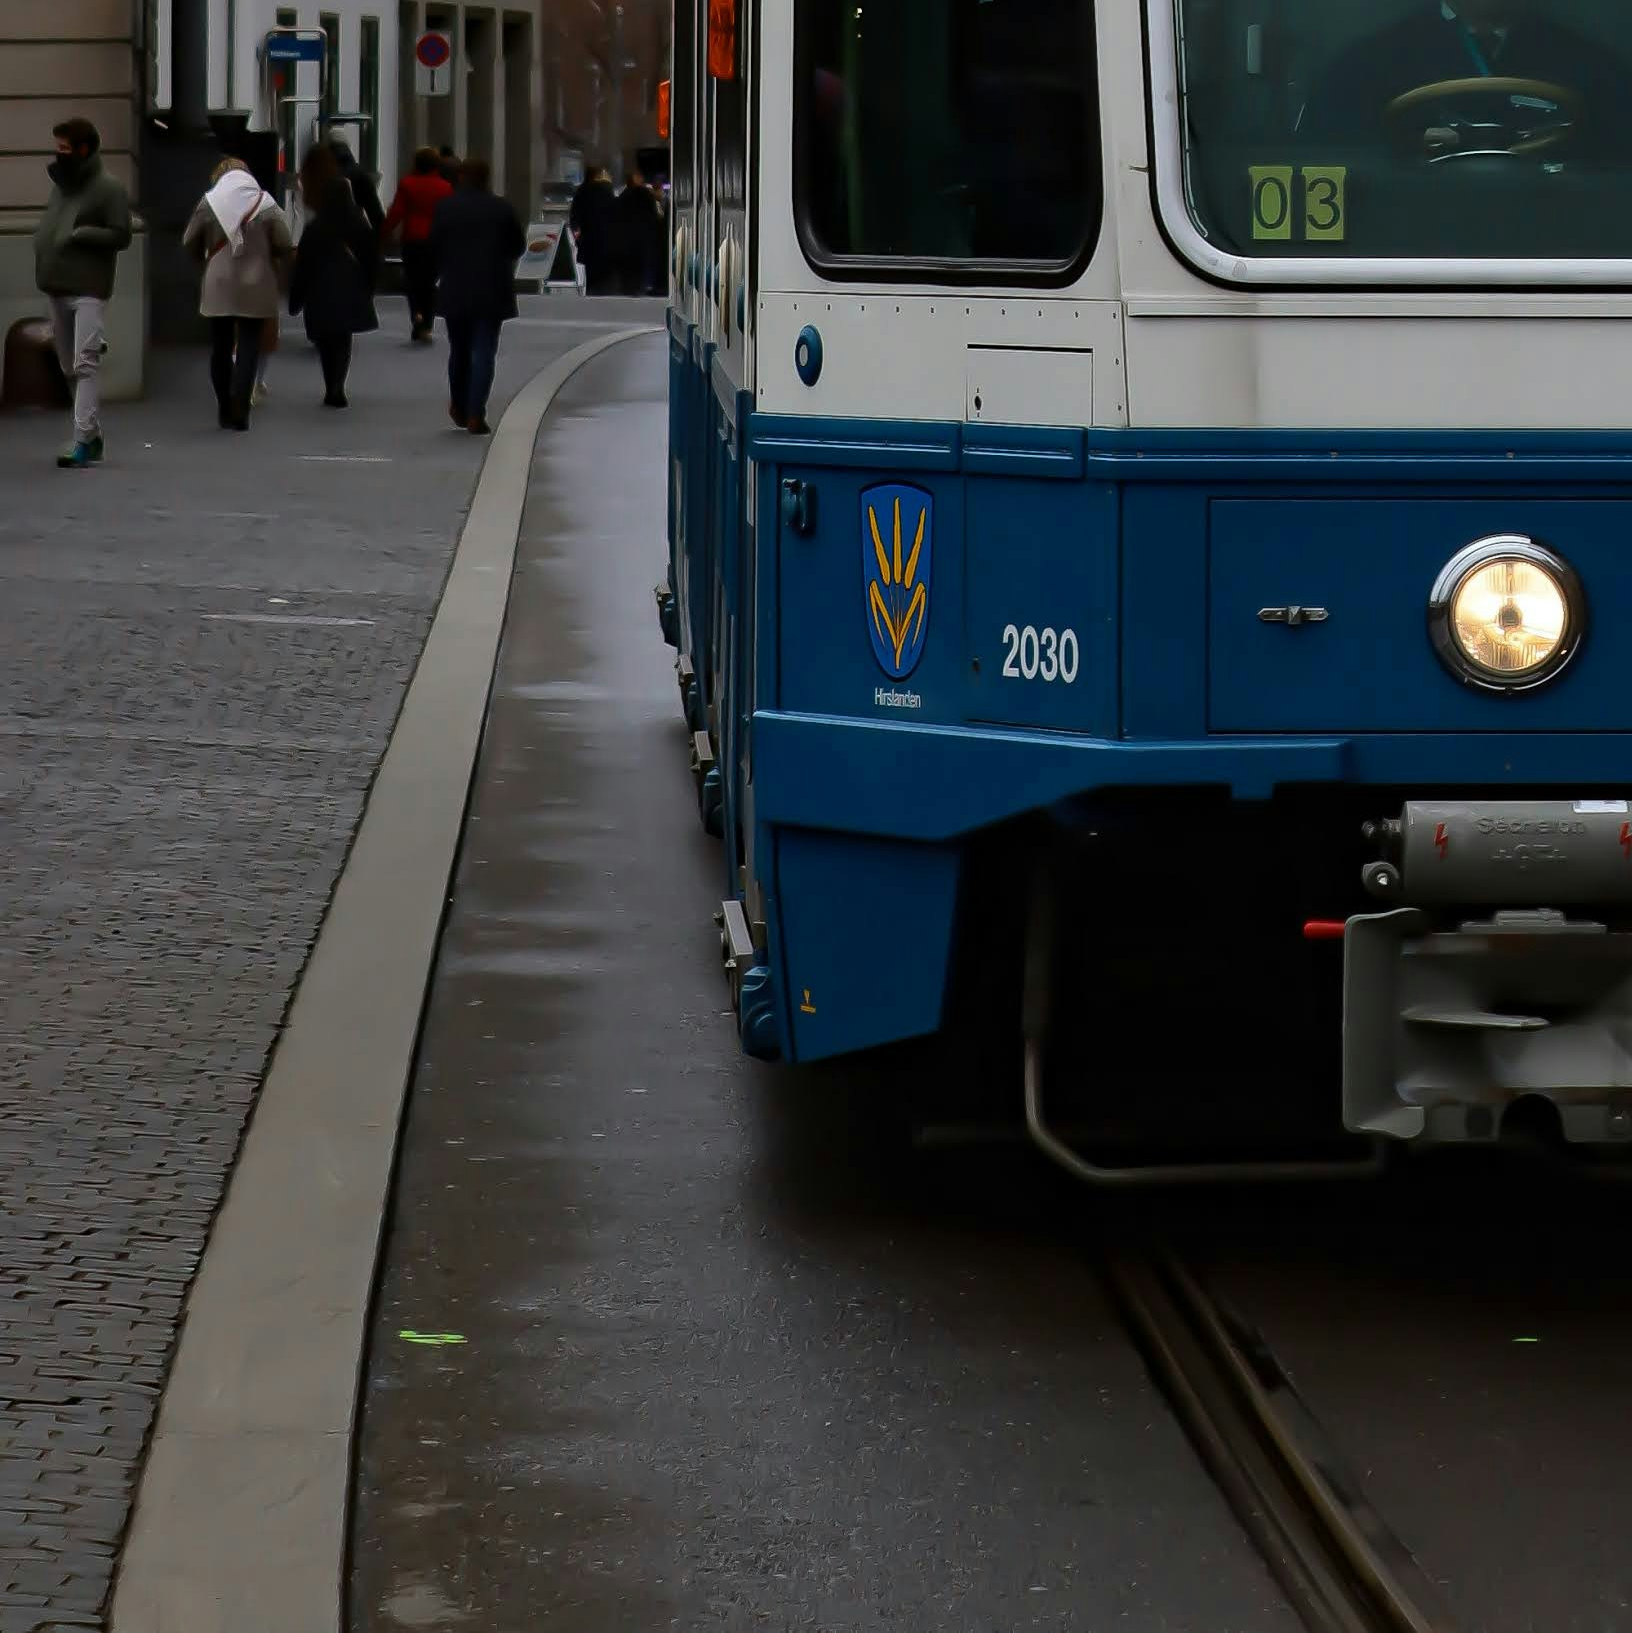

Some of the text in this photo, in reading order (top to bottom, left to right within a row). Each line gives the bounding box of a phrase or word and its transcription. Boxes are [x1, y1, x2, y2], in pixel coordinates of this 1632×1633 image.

[1254, 176, 1341, 230] 03
[1002, 623, 1079, 684] 2030
[874, 686, 921, 709] Hirslanden
